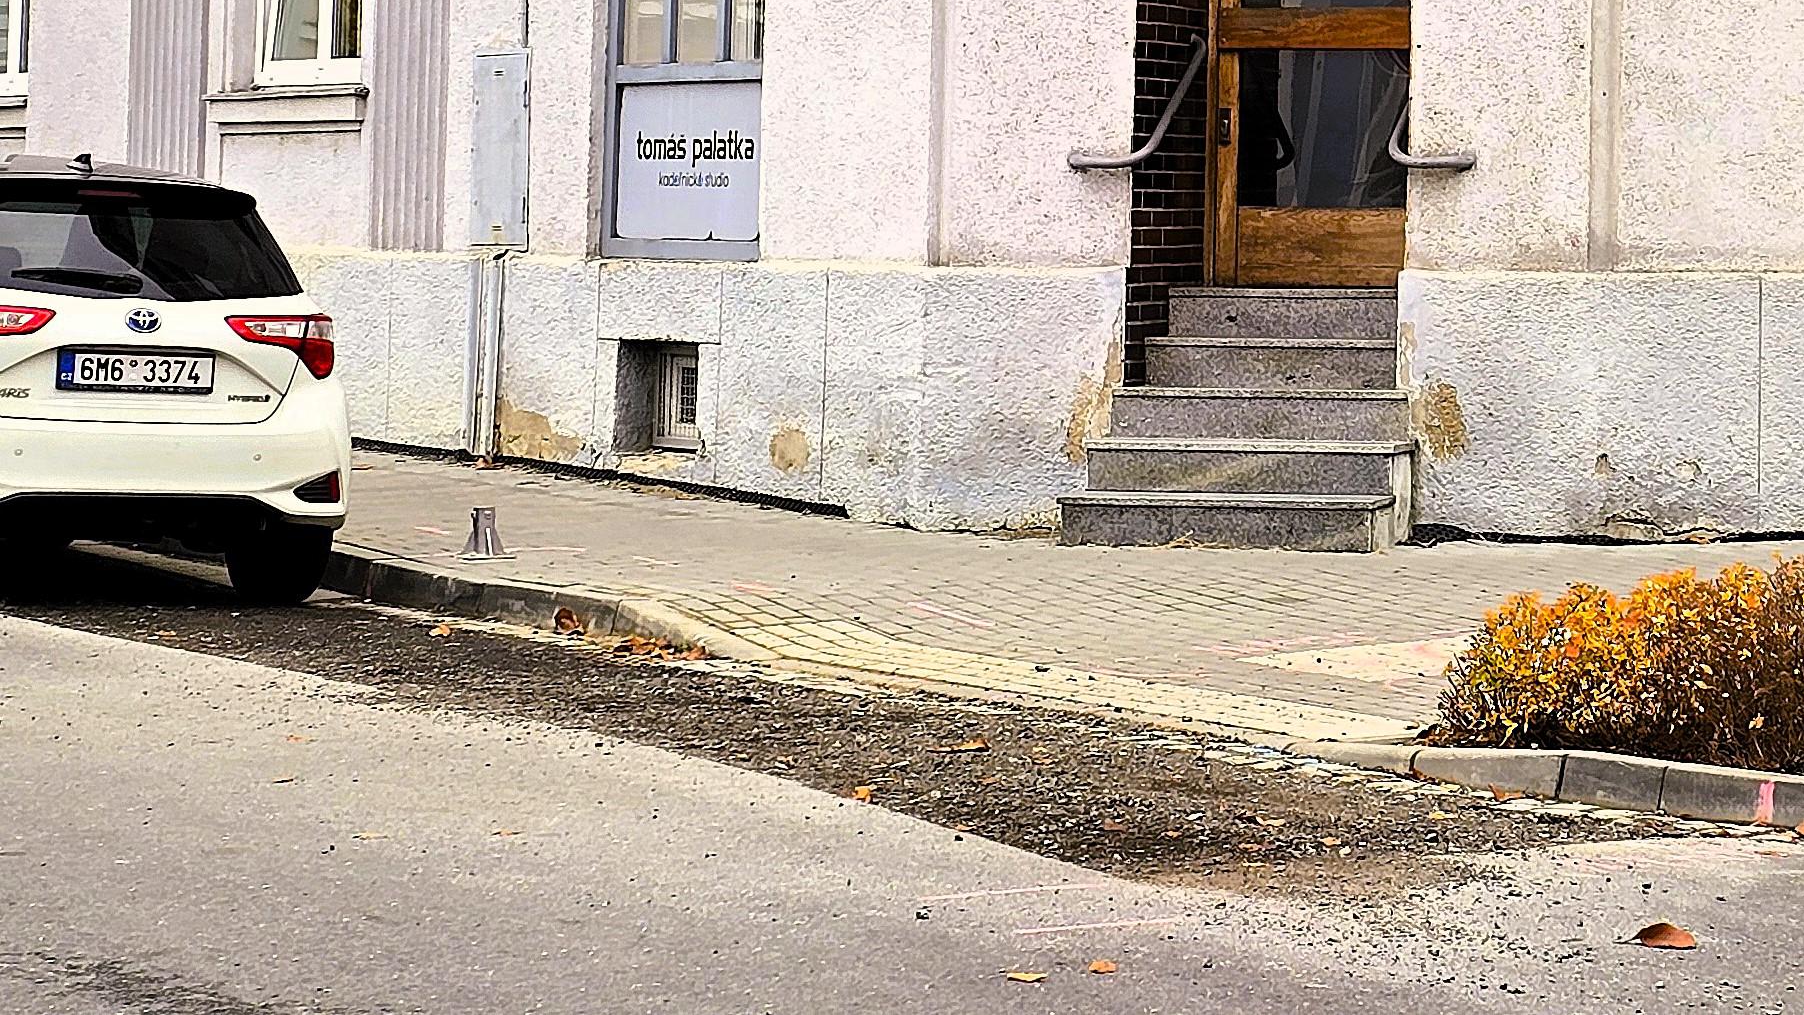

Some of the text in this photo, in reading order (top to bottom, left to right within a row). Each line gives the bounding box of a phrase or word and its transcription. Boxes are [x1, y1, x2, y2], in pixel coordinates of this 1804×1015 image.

[636, 129, 755, 168] tomáš palatka
[80, 357, 201, 385] 6M6 3374
